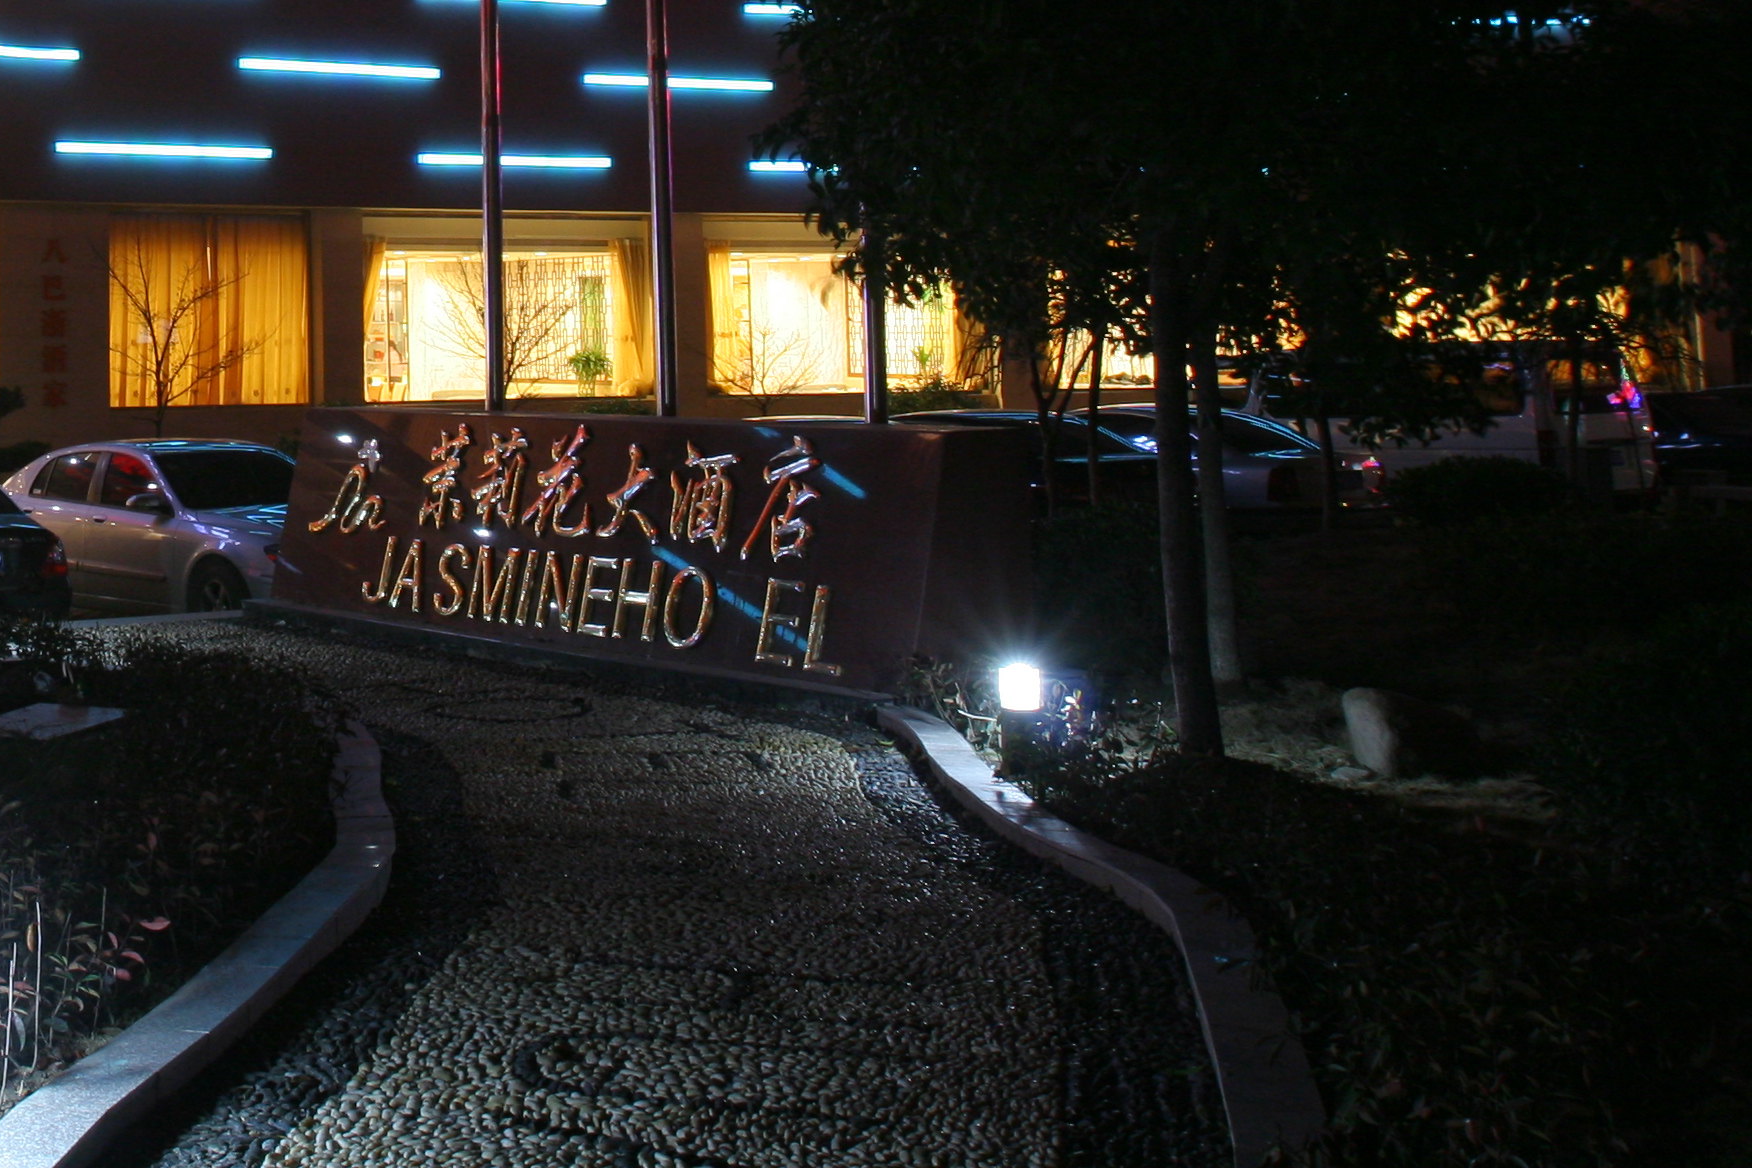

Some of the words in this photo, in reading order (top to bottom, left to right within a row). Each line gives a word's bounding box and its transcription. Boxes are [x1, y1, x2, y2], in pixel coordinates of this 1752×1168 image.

[418, 422, 822, 562] 茉莉花大酒店
